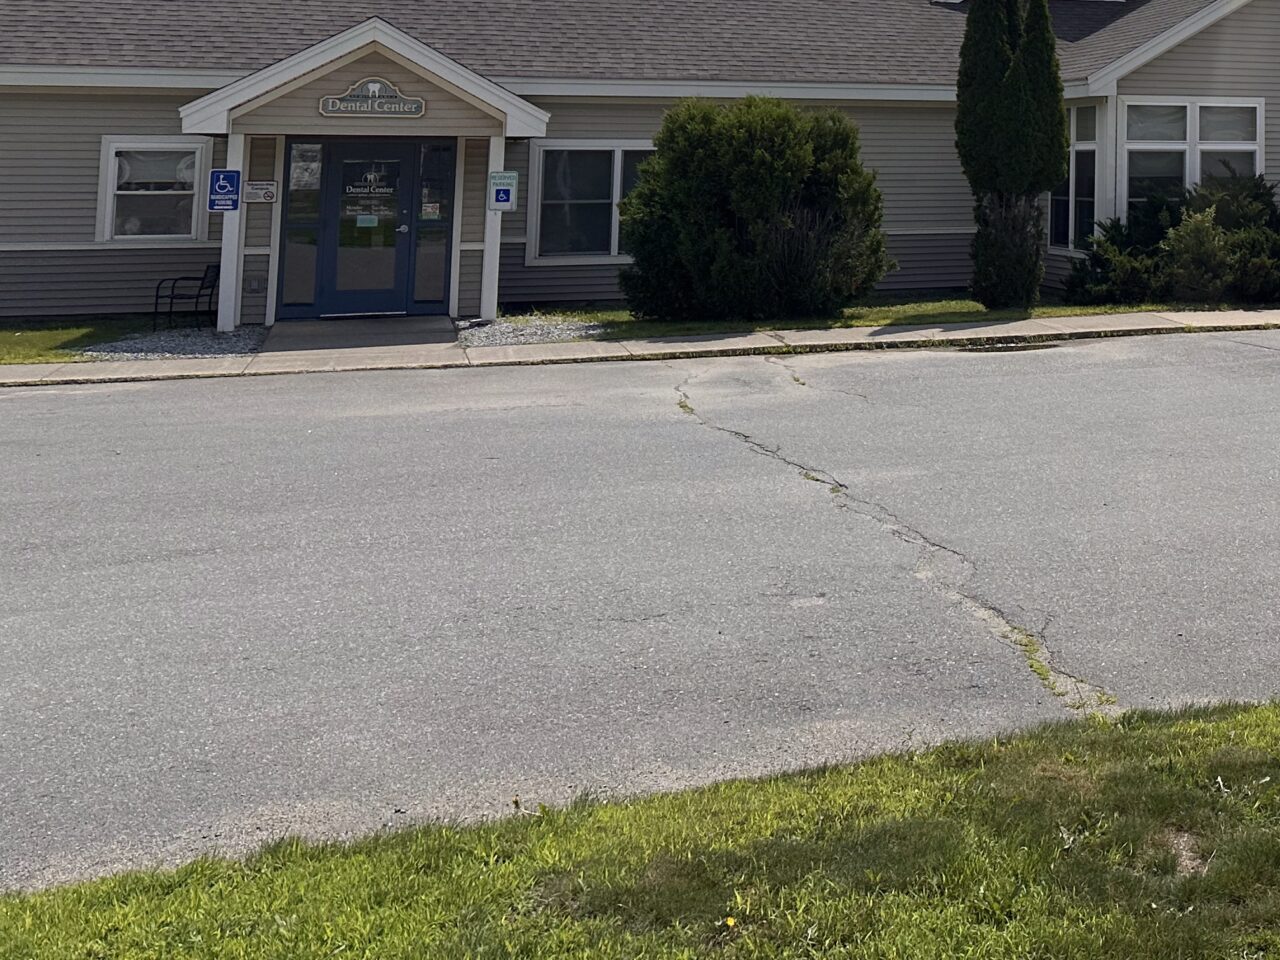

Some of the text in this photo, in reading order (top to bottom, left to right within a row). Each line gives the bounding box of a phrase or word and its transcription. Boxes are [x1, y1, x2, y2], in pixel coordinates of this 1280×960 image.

[328, 99, 418, 112] Dental Center
[346, 185, 394, 193] Dental Center
